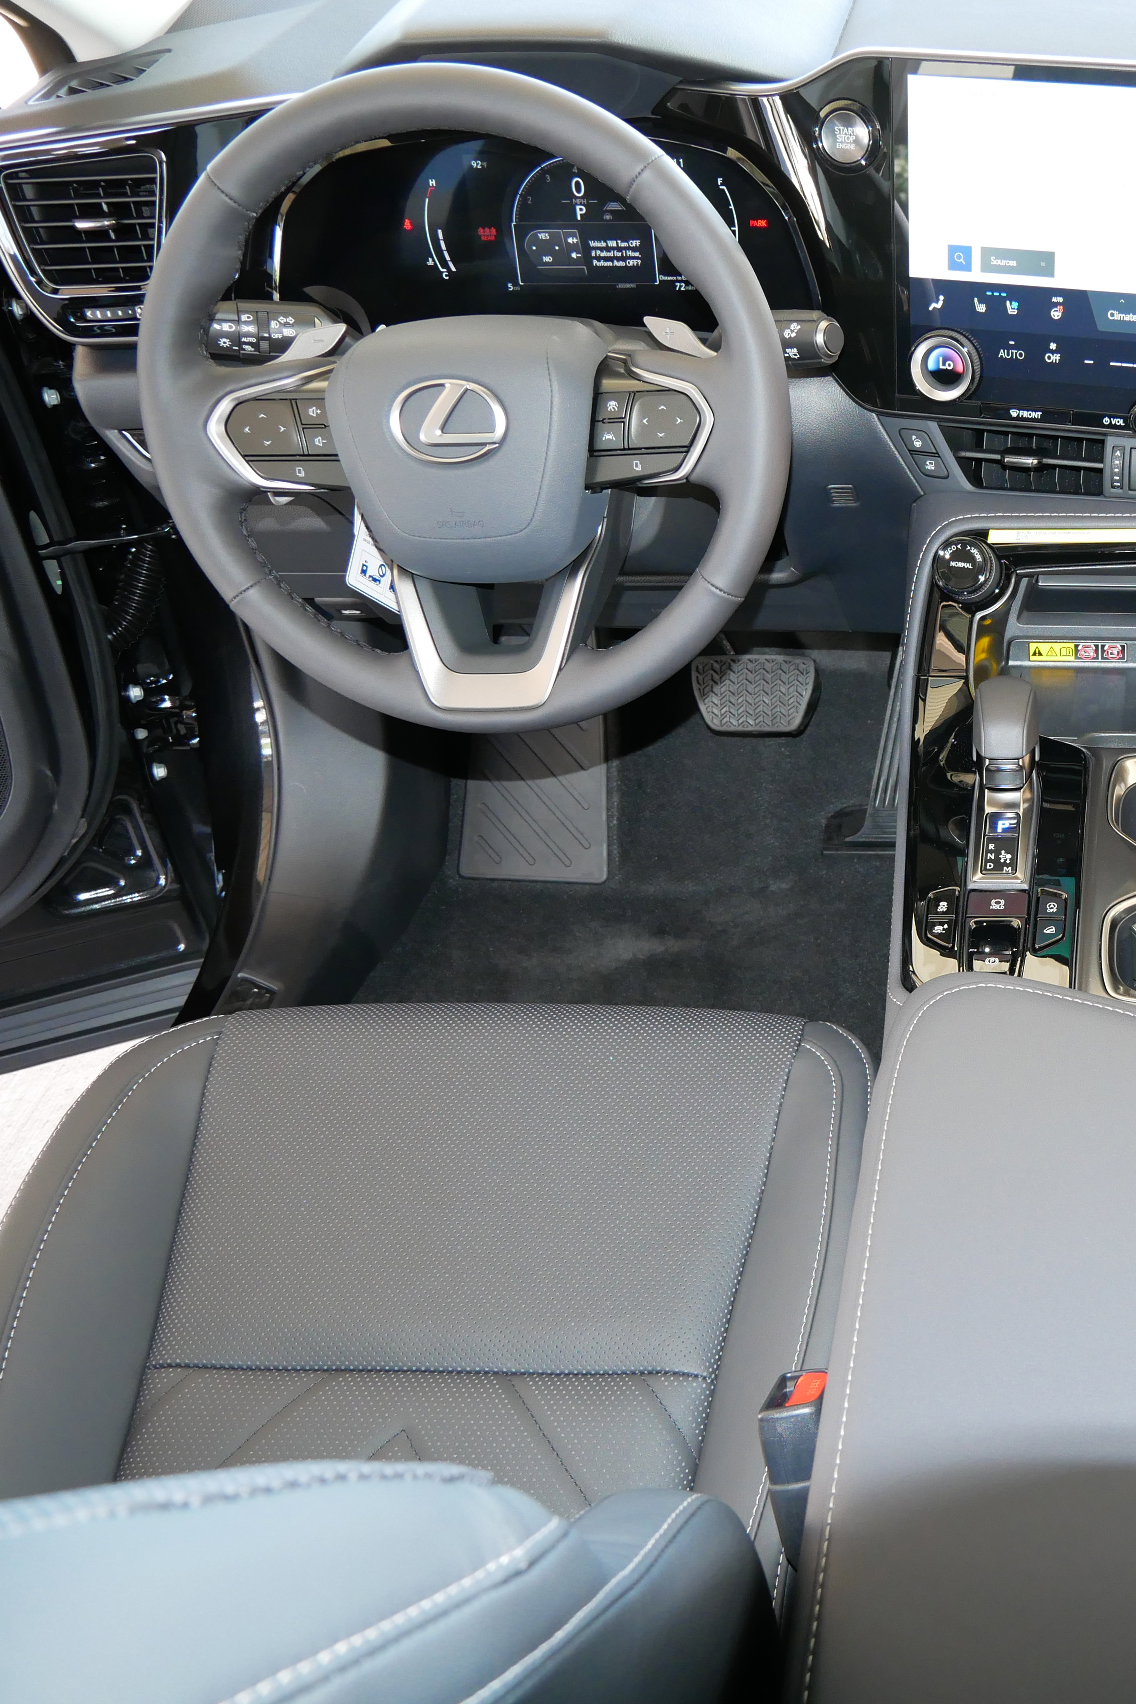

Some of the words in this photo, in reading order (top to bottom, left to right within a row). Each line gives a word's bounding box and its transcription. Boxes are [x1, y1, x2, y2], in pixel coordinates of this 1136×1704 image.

[834, 126, 857, 136] START
[836, 135, 856, 143] STOP
[429, 179, 436, 187] H
[545, 174, 551, 183] 3
[717, 177, 723, 186] F
[575, 205, 587, 221] P
[749, 219, 769, 228] PARK
[588, 240, 606, 248] Vehicle
[606, 240, 617, 248] Will
[596, 249, 614, 257] Parked
[542, 255, 553, 263] NO
[592, 259, 613, 267] Perform
[613, 259, 626, 267] Auto
[626, 259, 642, 267] OFF?
[990, 256, 1017, 267] Sources
[442, 272, 449, 280] C
[998, 349, 1025, 360] AUTO
[1044, 353, 1061, 364] Off
[939, 356, 954, 371] Lo
[1019, 410, 1043, 420] FRONT
[1110, 418, 1125, 426] VOL
[970, 546, 983, 562] SPORT
[950, 561, 974, 569] NORMAL
[997, 820, 1010, 833] P
